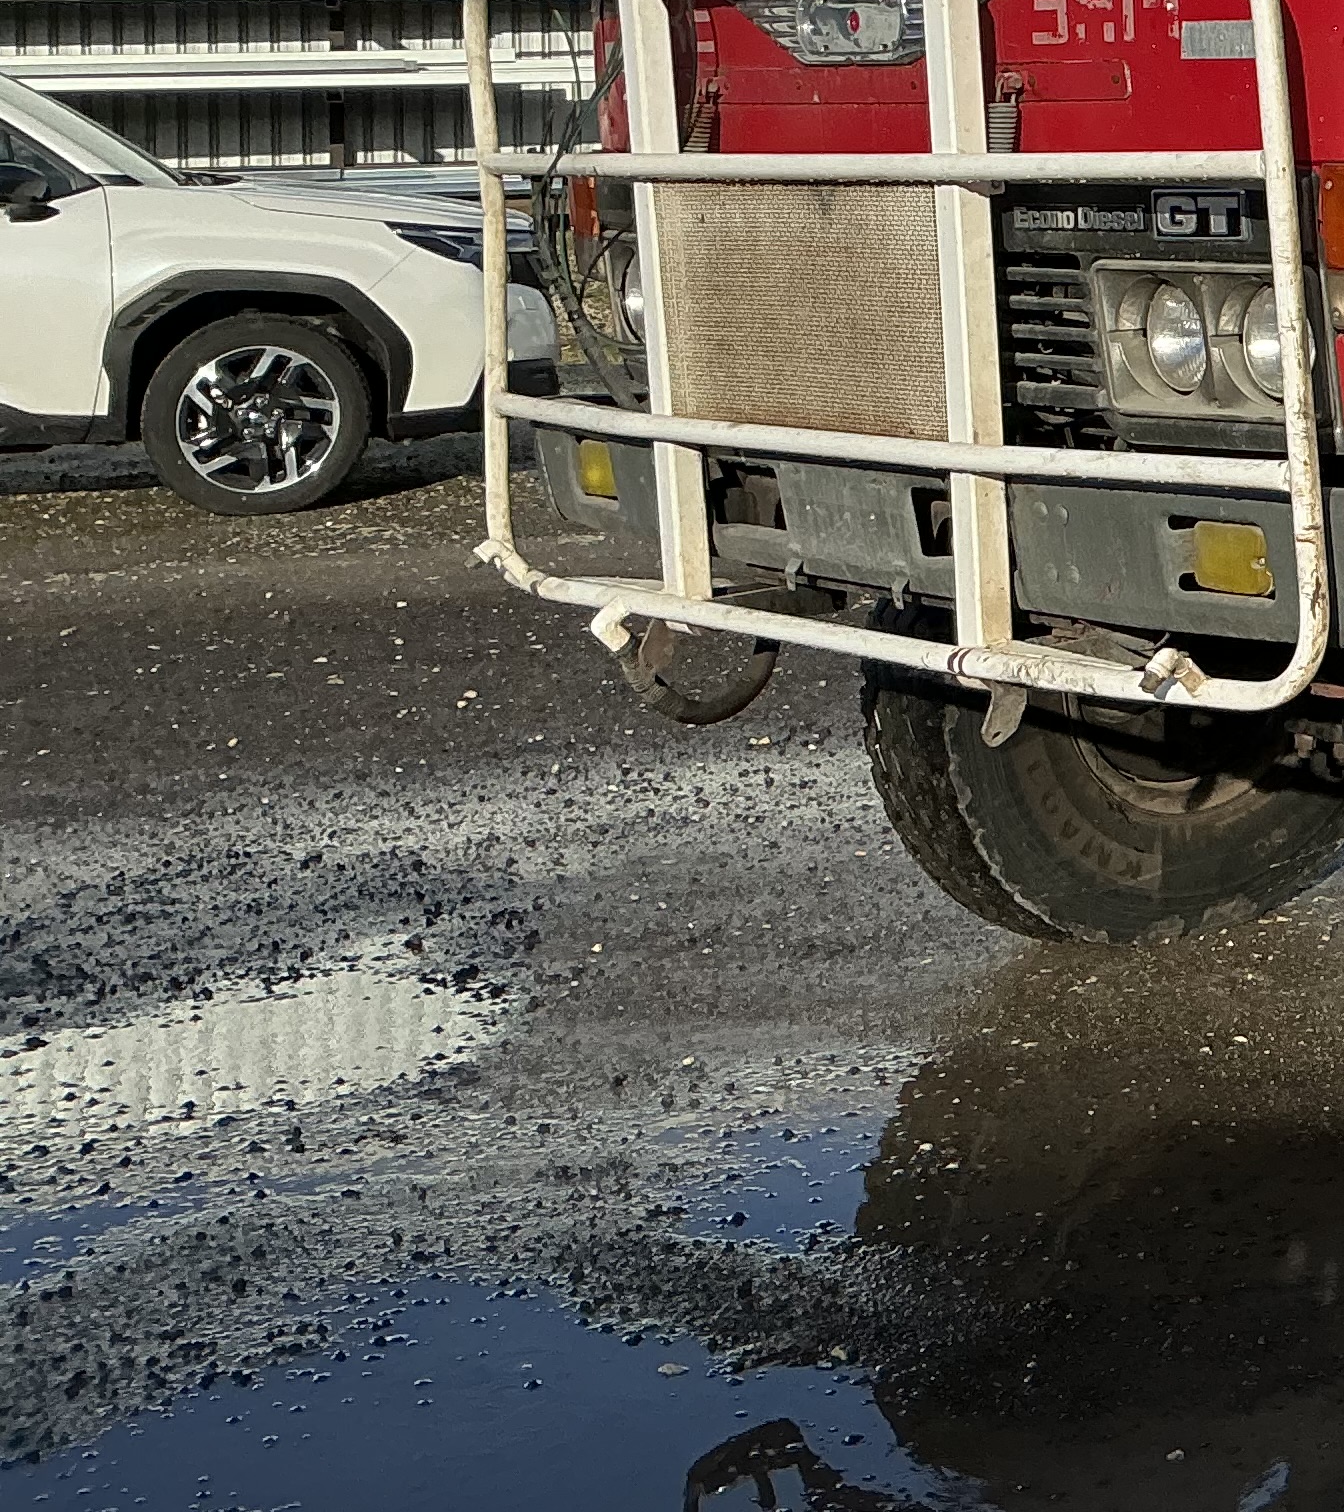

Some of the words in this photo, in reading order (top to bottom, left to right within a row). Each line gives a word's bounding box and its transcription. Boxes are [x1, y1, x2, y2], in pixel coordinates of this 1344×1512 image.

[1013, 206, 1075, 230] Econo
[1078, 206, 1144, 231] Diesel
[1155, 195, 1240, 235] GT
